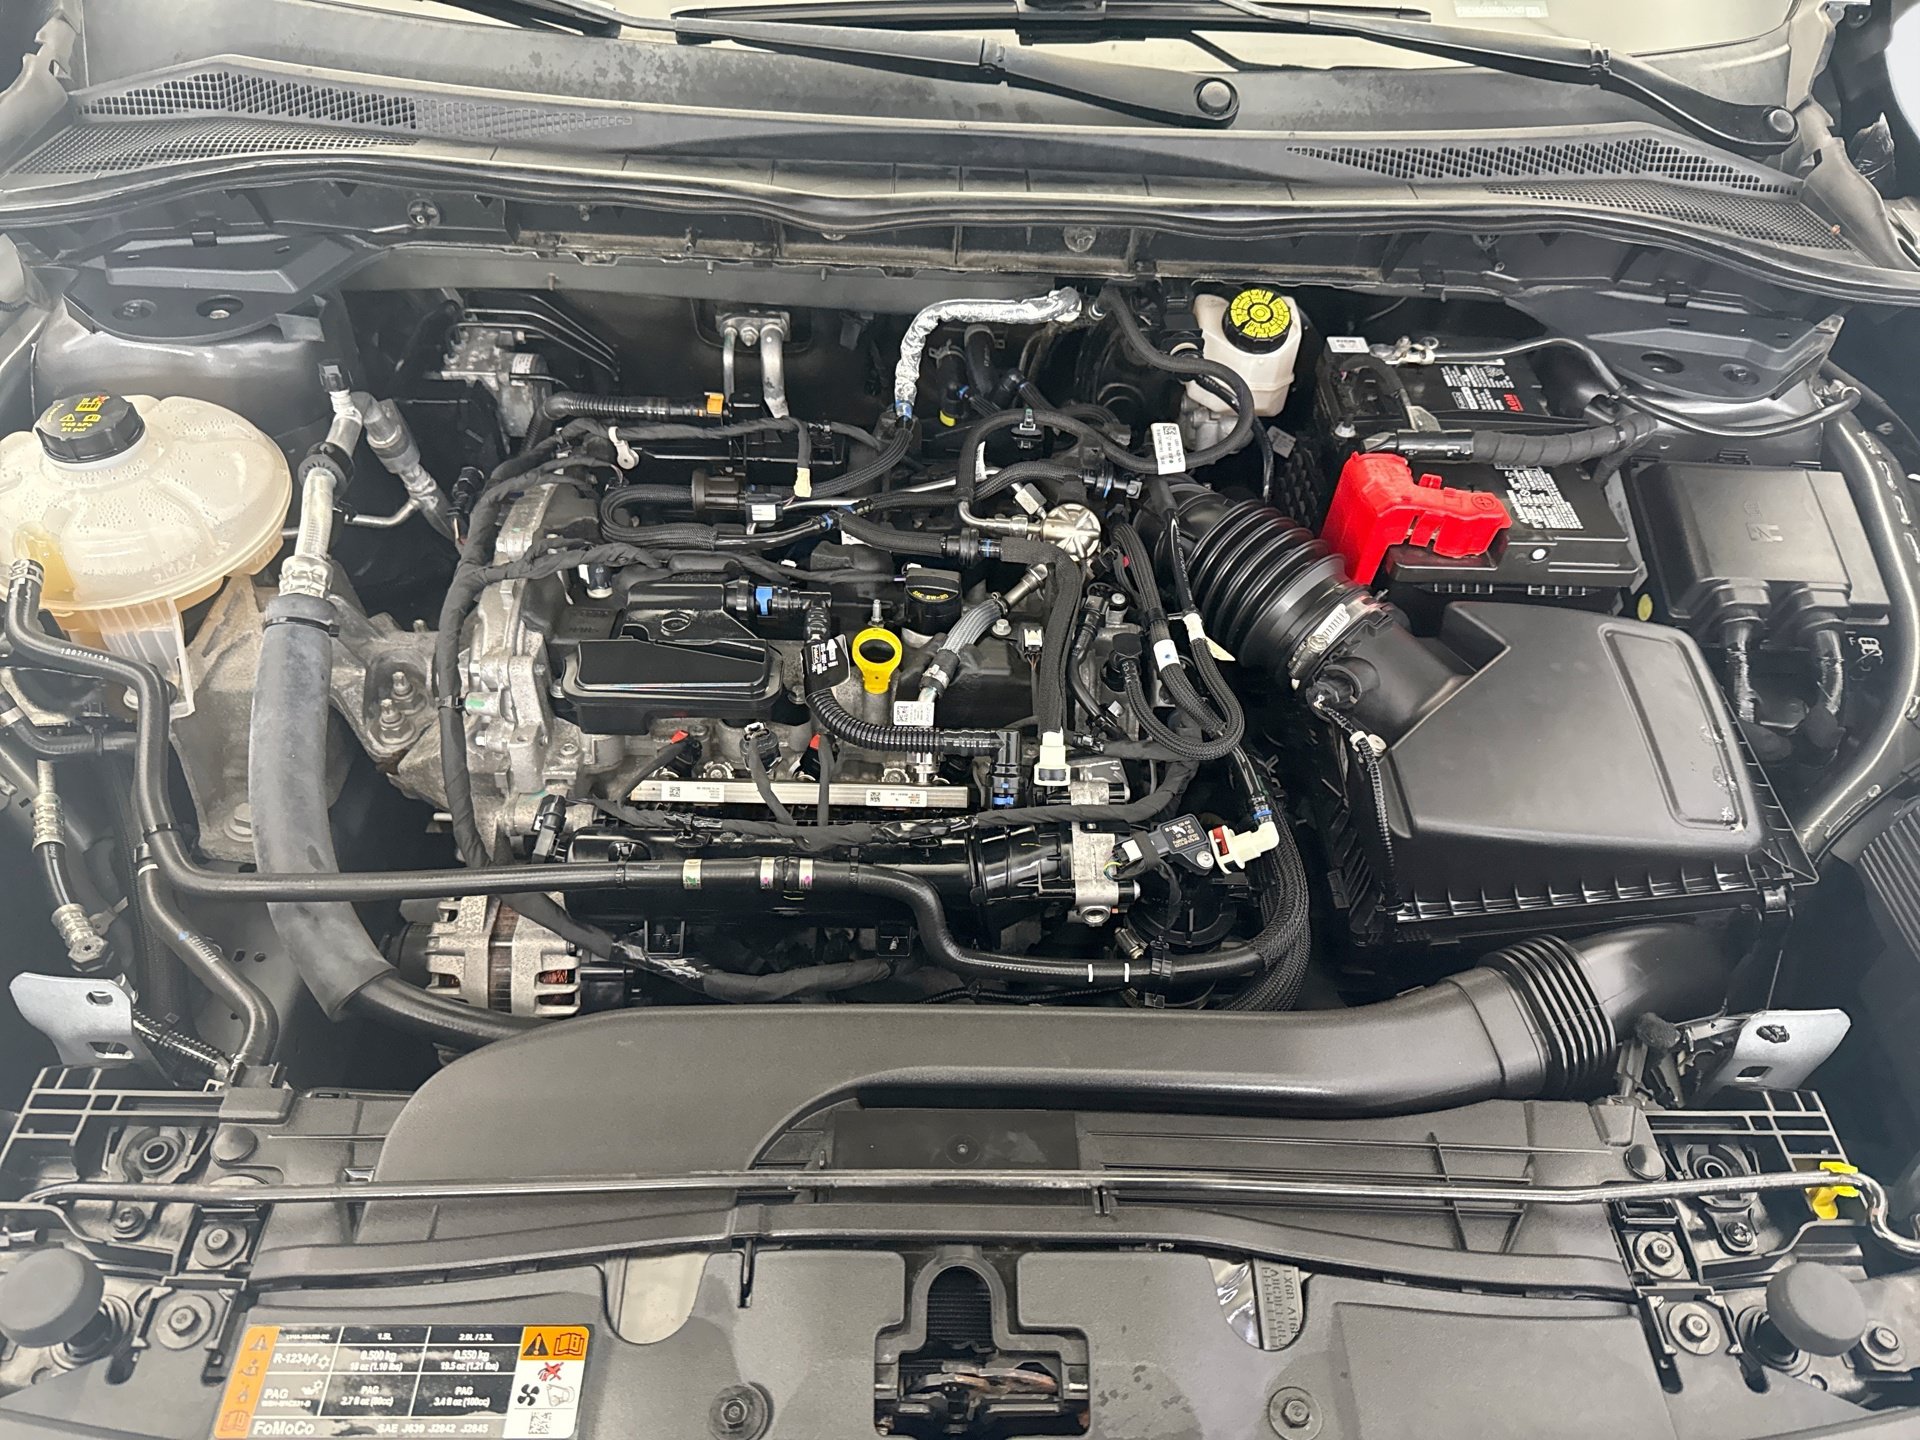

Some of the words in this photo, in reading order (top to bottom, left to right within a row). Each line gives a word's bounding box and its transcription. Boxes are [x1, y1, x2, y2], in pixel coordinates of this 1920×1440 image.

[1504, 393, 1522, 411] AGM
[377, 1332, 393, 1340] 1.5L
[458, 1333, 475, 1341] 2.0L
[478, 1333, 494, 1341] 2.3L
[273, 1353, 318, 1366] R-1234yf
[360, 1350, 384, 1361] 0.500
[385, 1350, 398, 1362] kg
[453, 1350, 476, 1360] 0.550
[477, 1350, 490, 1362] kg
[388, 1362, 403, 1372] lbs)
[466, 1362, 484, 1372] (1.21
[484, 1362, 500, 1372] lbs)
[264, 1388, 289, 1399] PAG
[360, 1385, 380, 1394] PAG
[454, 1386, 474, 1395] PAG
[341, 1397, 354, 1405] 2.7
[433, 1397, 446, 1406] 3.4
[463, 1397, 491, 1407] (100cc)
[253, 1421, 315, 1435] FoMoCo
[377, 1424, 399, 1433] SAE
[401, 1424, 425, 1433] J639
[427, 1424, 457, 1433] J2842
[461, 1424, 489, 1433] J2845
